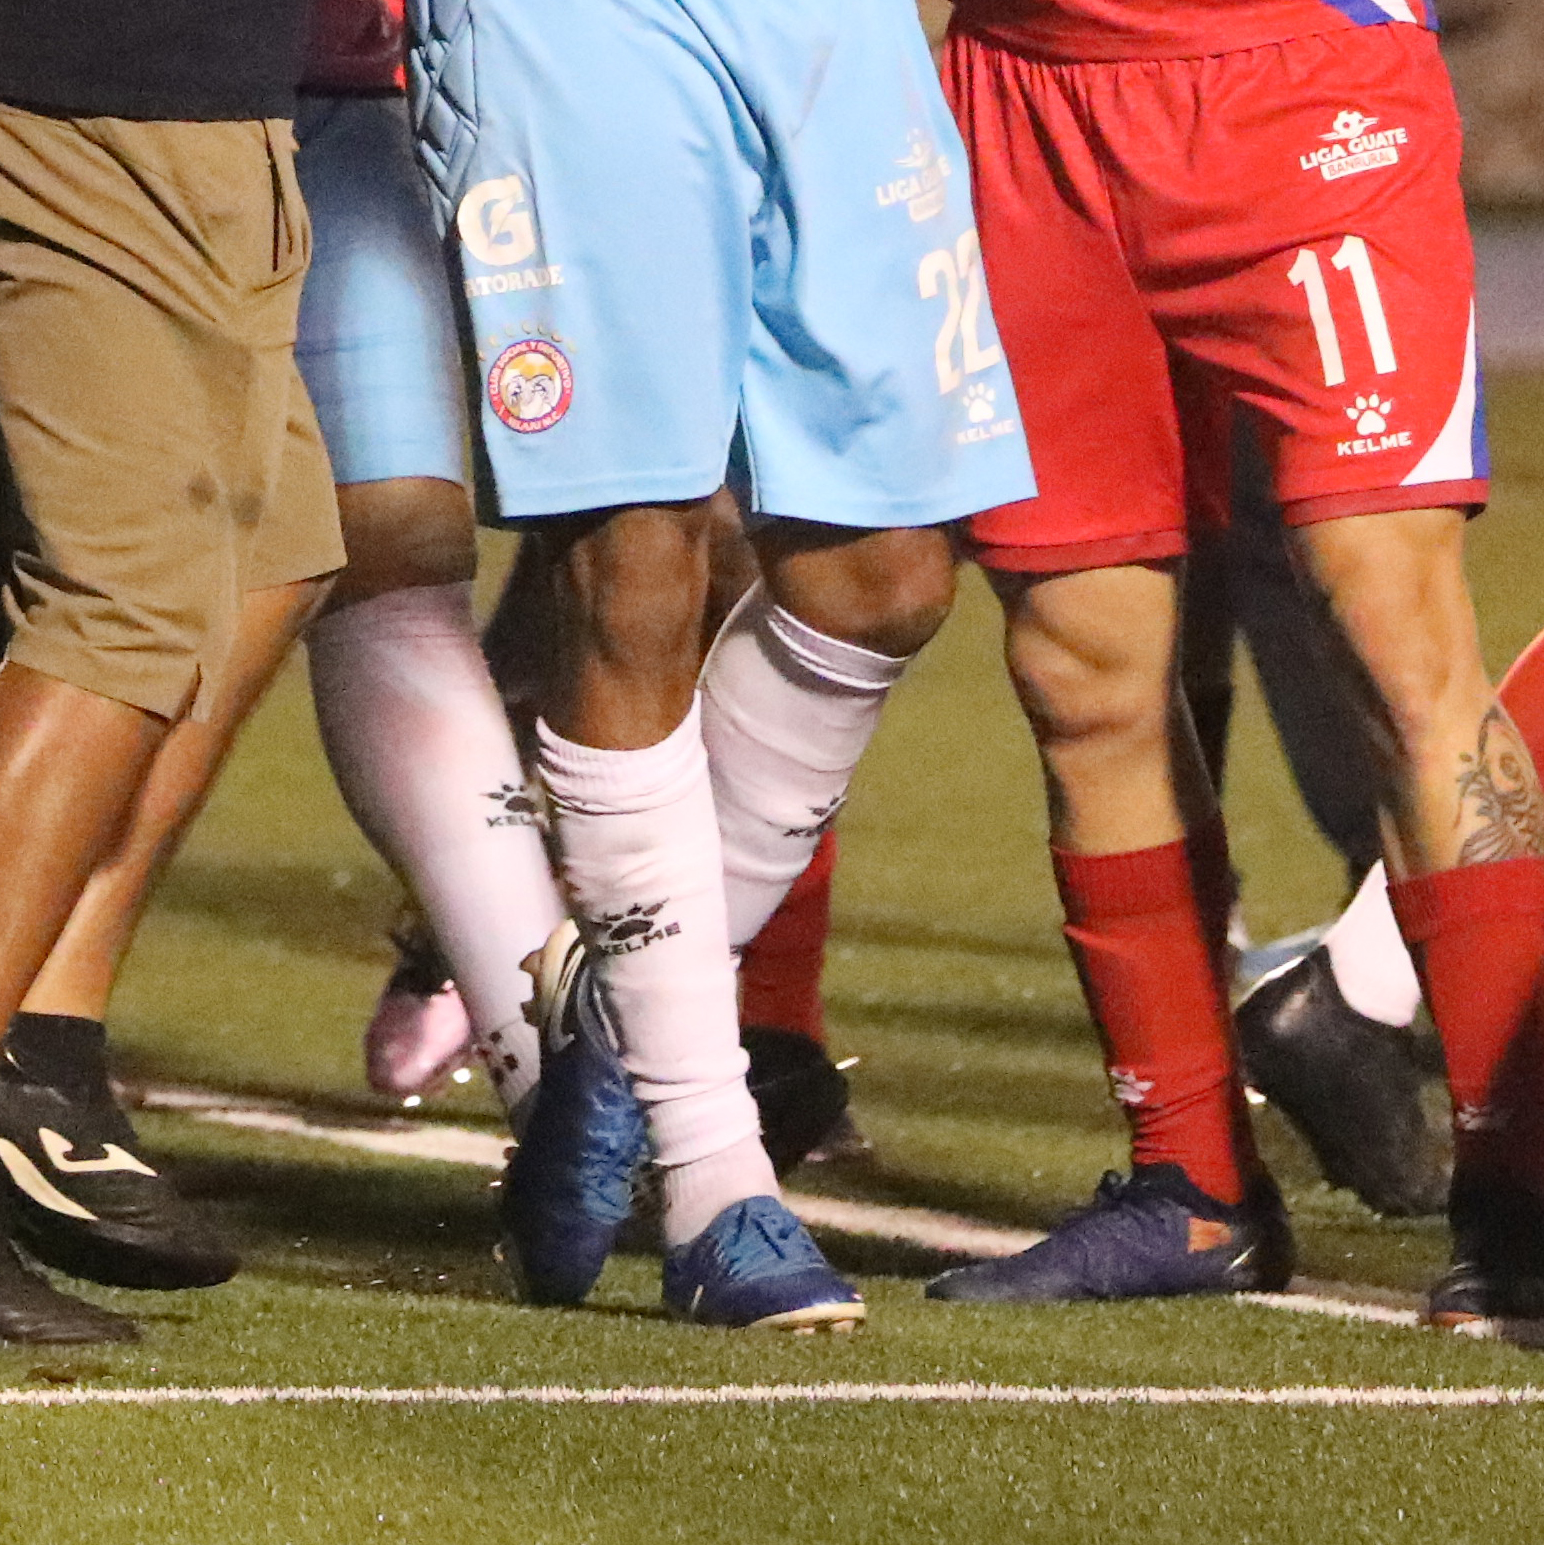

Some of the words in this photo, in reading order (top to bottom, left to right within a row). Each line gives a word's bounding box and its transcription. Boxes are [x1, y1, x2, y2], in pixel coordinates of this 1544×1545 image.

[1298, 143, 1348, 171] LIGA
[1347, 126, 1408, 154] GUATE
[1286, 234, 1398, 388] 11
[1336, 430, 1413, 457] KELME
